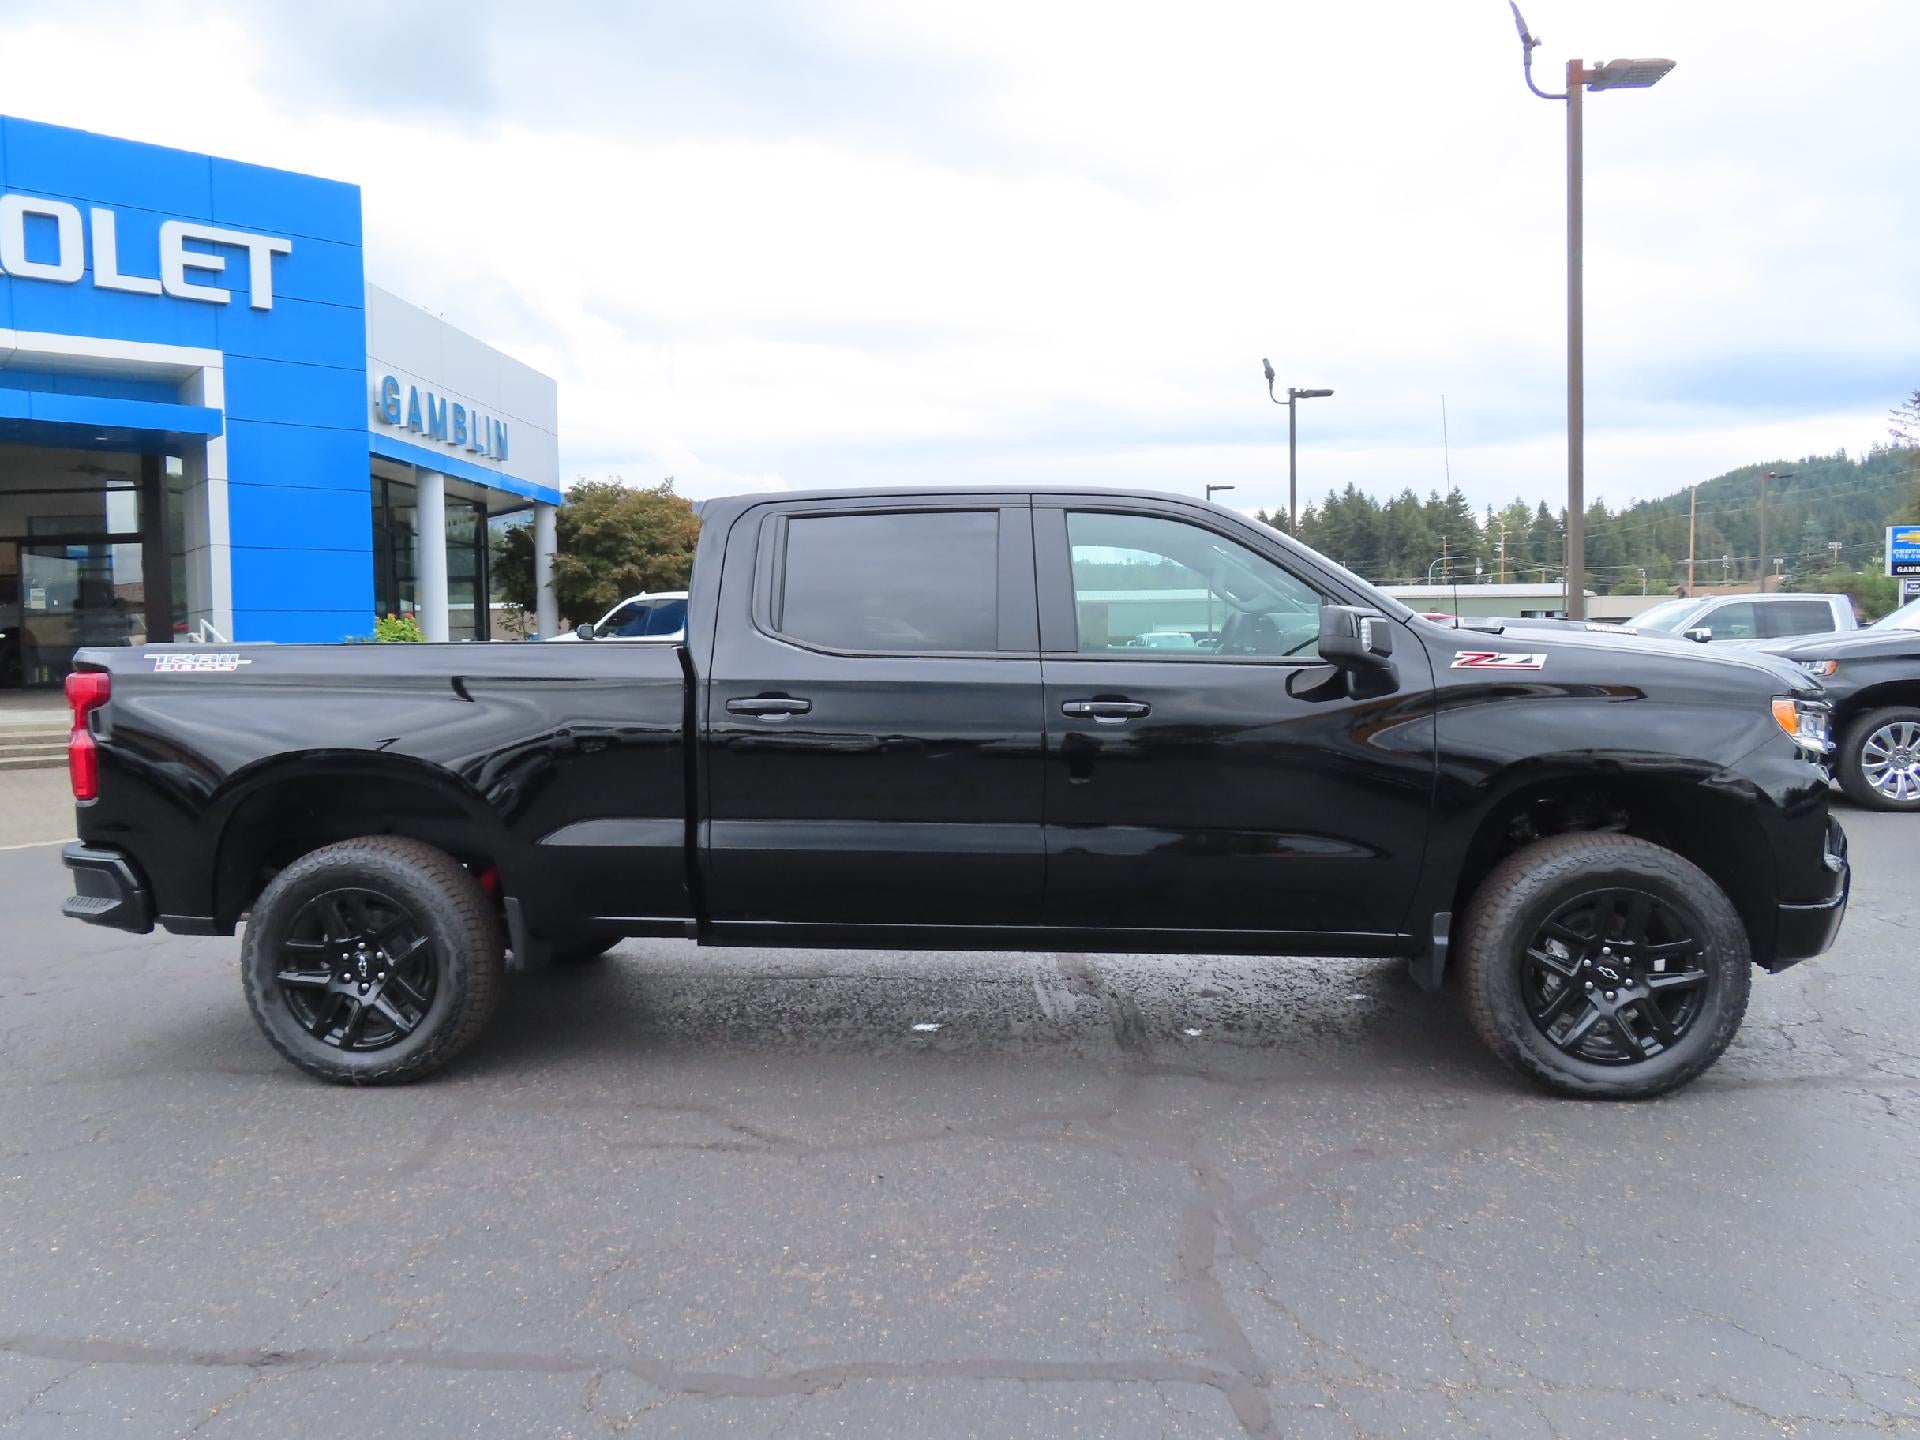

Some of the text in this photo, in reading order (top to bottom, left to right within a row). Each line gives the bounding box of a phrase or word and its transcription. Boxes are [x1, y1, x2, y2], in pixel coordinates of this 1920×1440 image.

[376, 375, 508, 462] GAMBLIN
[144, 654, 252, 664] TRAIL
[1450, 651, 1548, 670] Z71
[154, 663, 239, 672] BOSS
